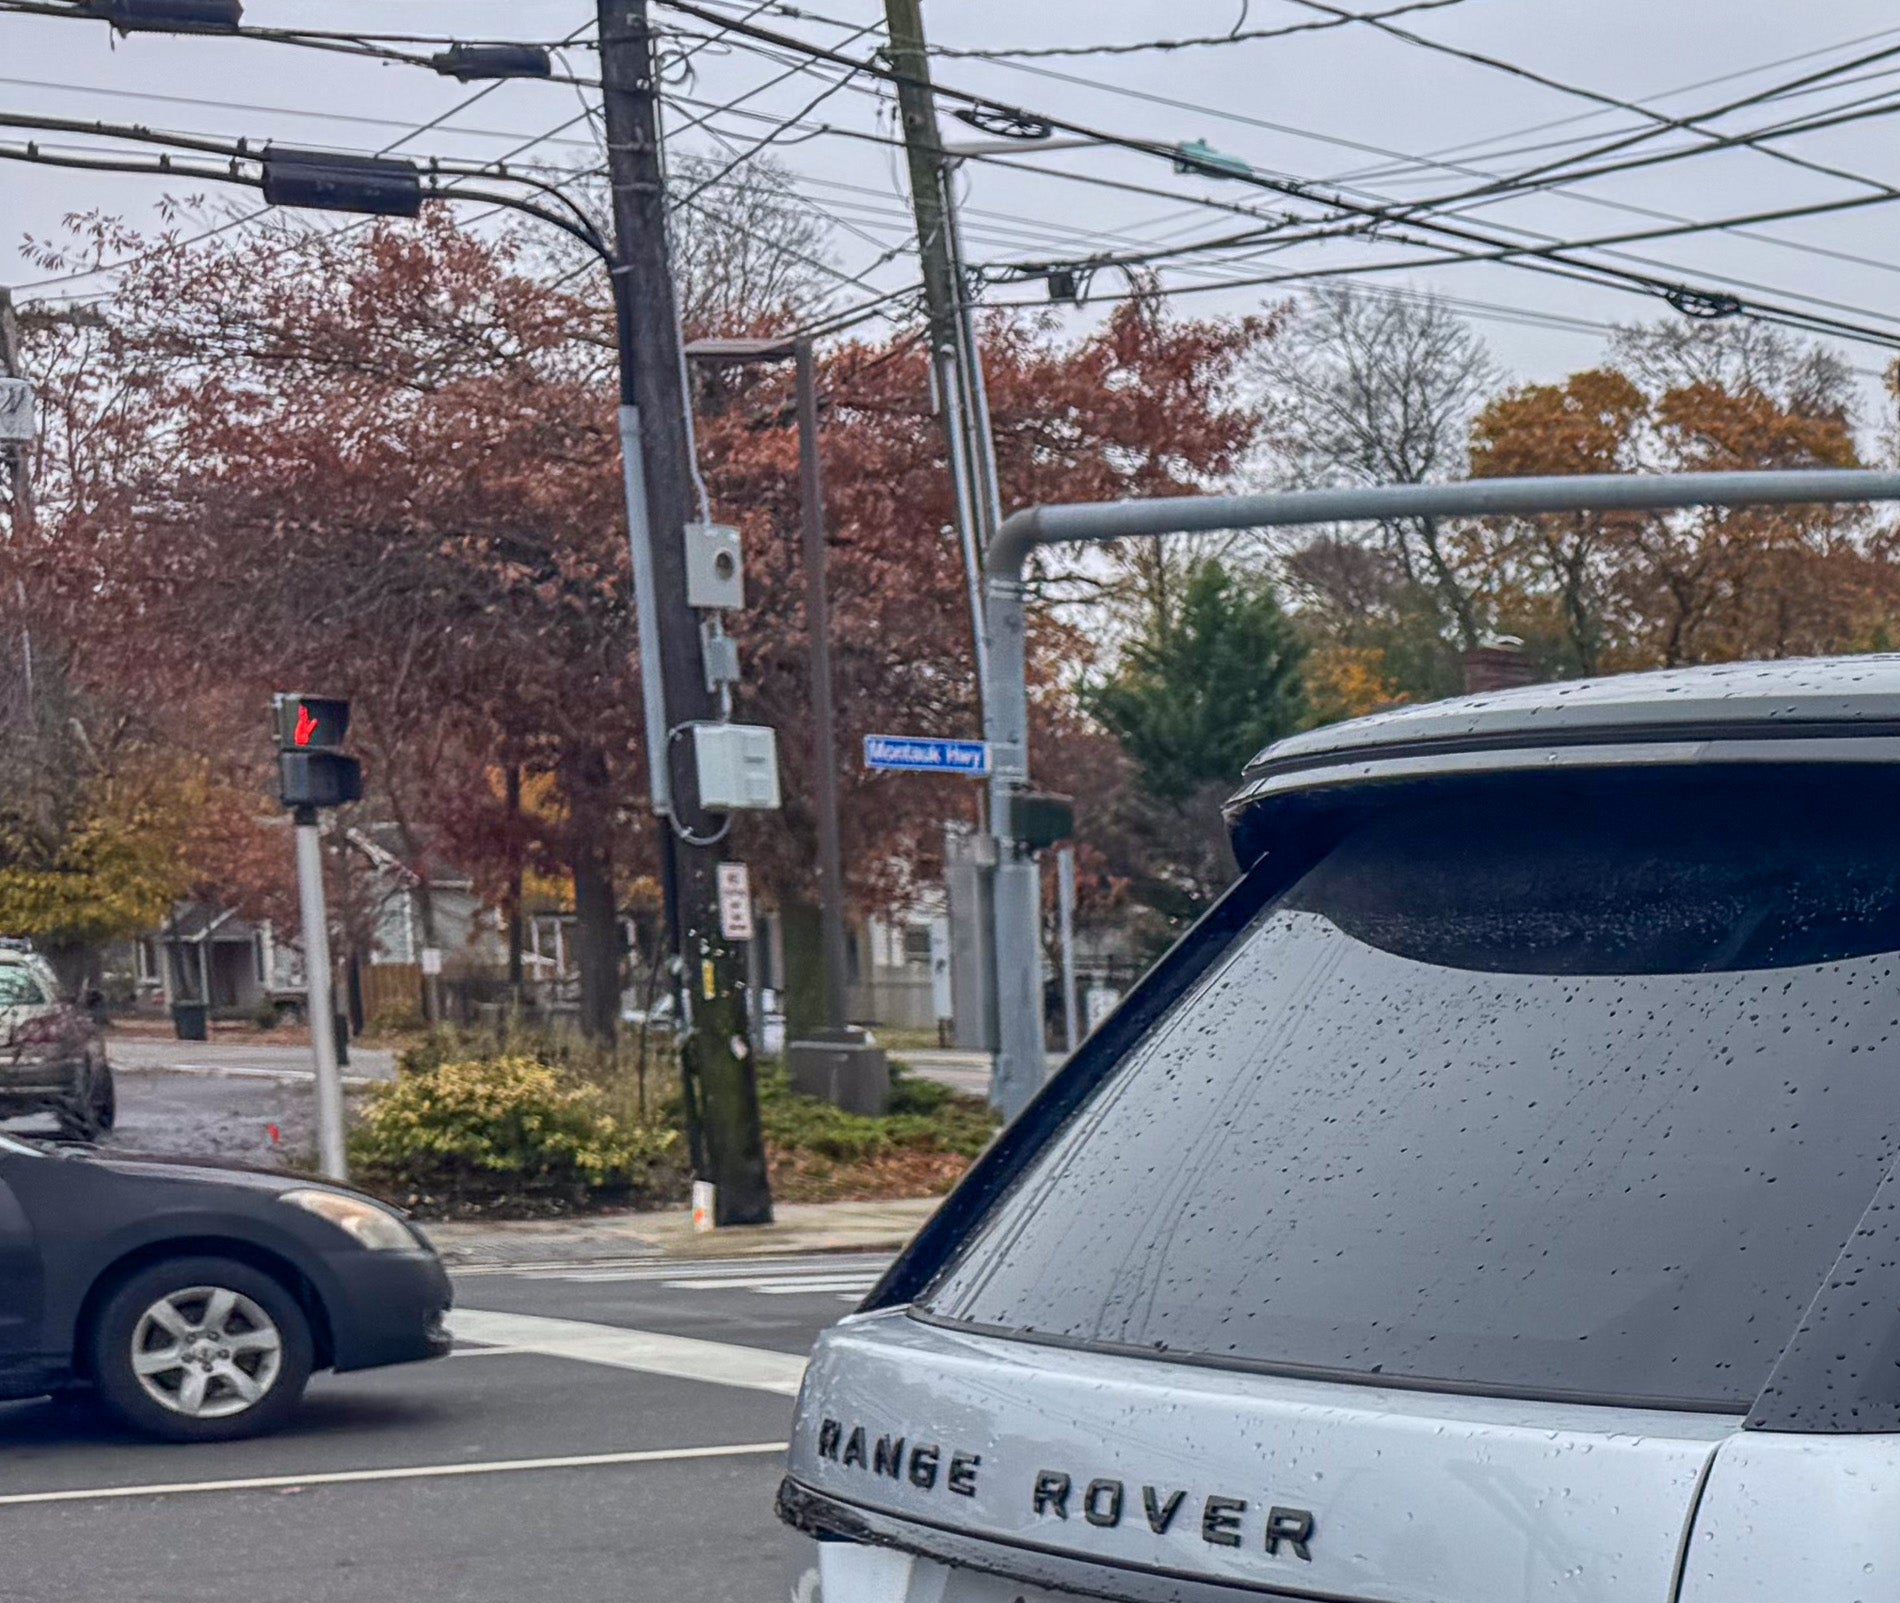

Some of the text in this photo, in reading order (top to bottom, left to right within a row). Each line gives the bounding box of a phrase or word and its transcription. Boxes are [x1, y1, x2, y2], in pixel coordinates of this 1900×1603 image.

[868, 741, 980, 769] Montauk Hwy
[819, 1419, 1316, 1562] RANGE ROVER
